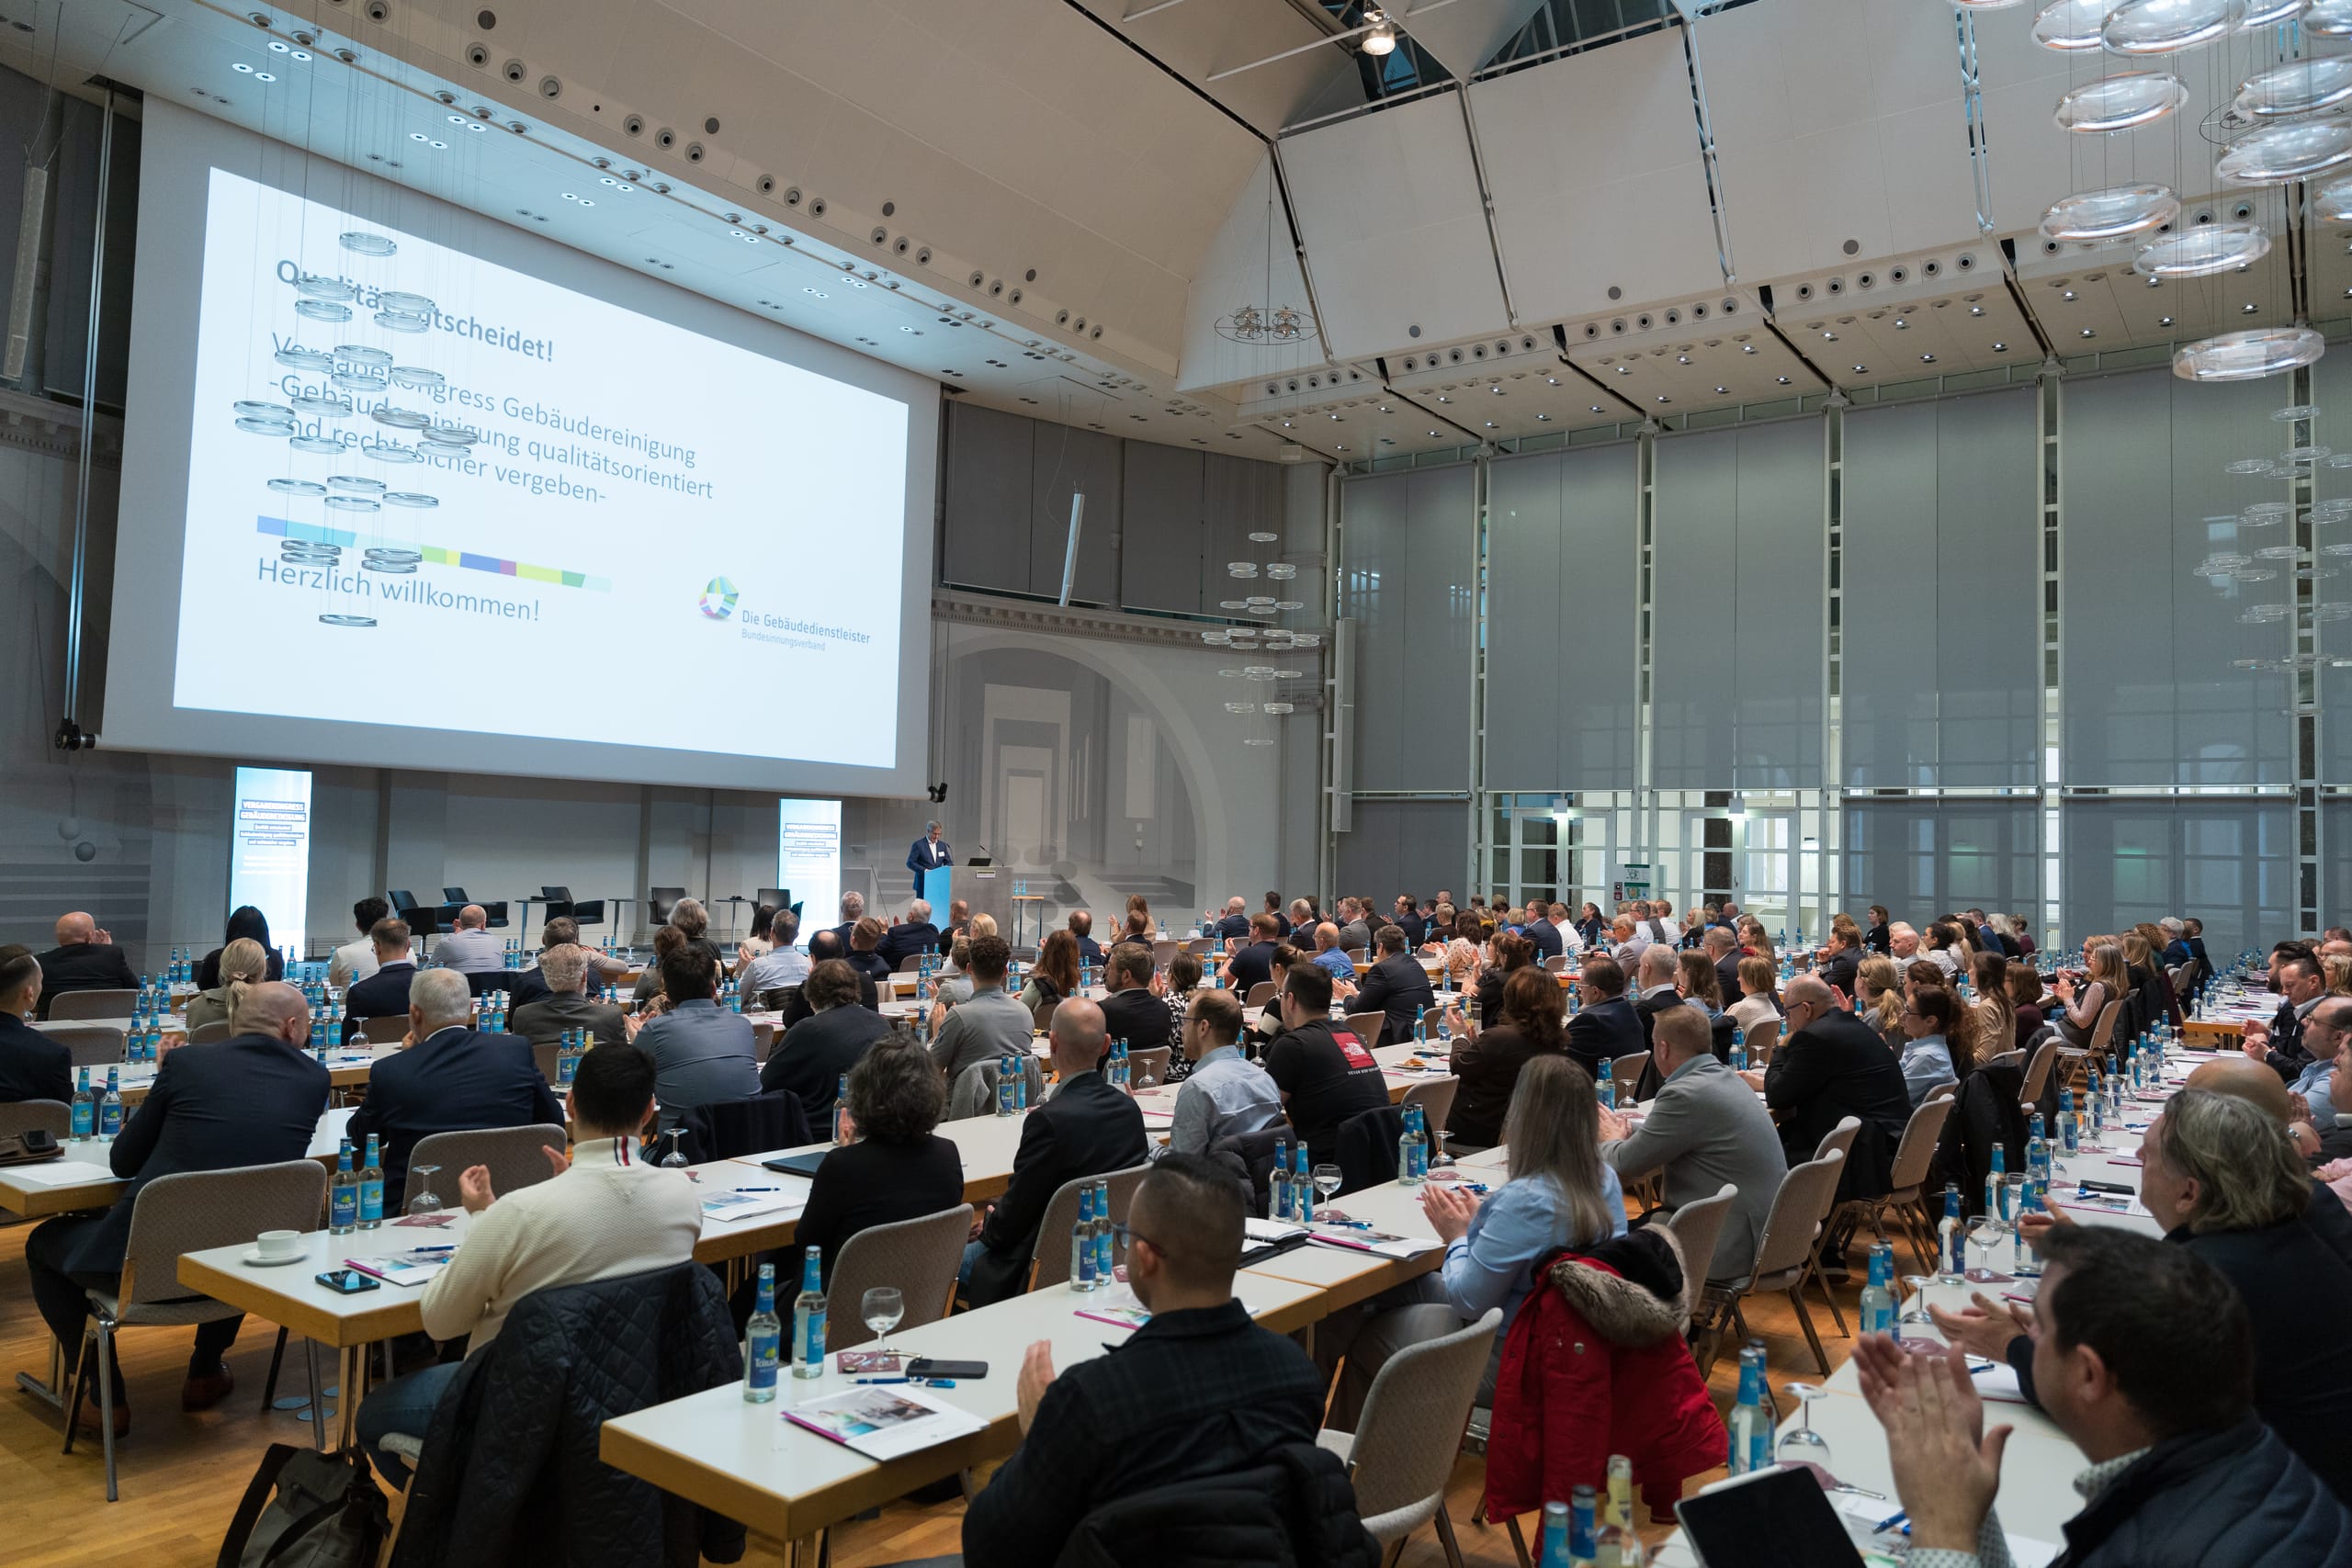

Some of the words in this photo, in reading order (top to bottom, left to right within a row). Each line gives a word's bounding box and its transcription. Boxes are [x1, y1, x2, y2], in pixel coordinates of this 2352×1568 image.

[416, 307, 552, 362] tscheidet!
[269, 375, 520, 456] -Gebäudiniung
[527, 441, 713, 500] qualitätsorientiert
[288, 416, 320, 438] nd
[495, 466, 606, 502] vergeben-
[503, 397, 695, 468] Gebäudereinigung
[258, 558, 370, 596] Herzlich
[381, 580, 539, 621] willkommen!
[742, 610, 760, 626] Die
[763, 614, 871, 644] Gebäudedienstleister
